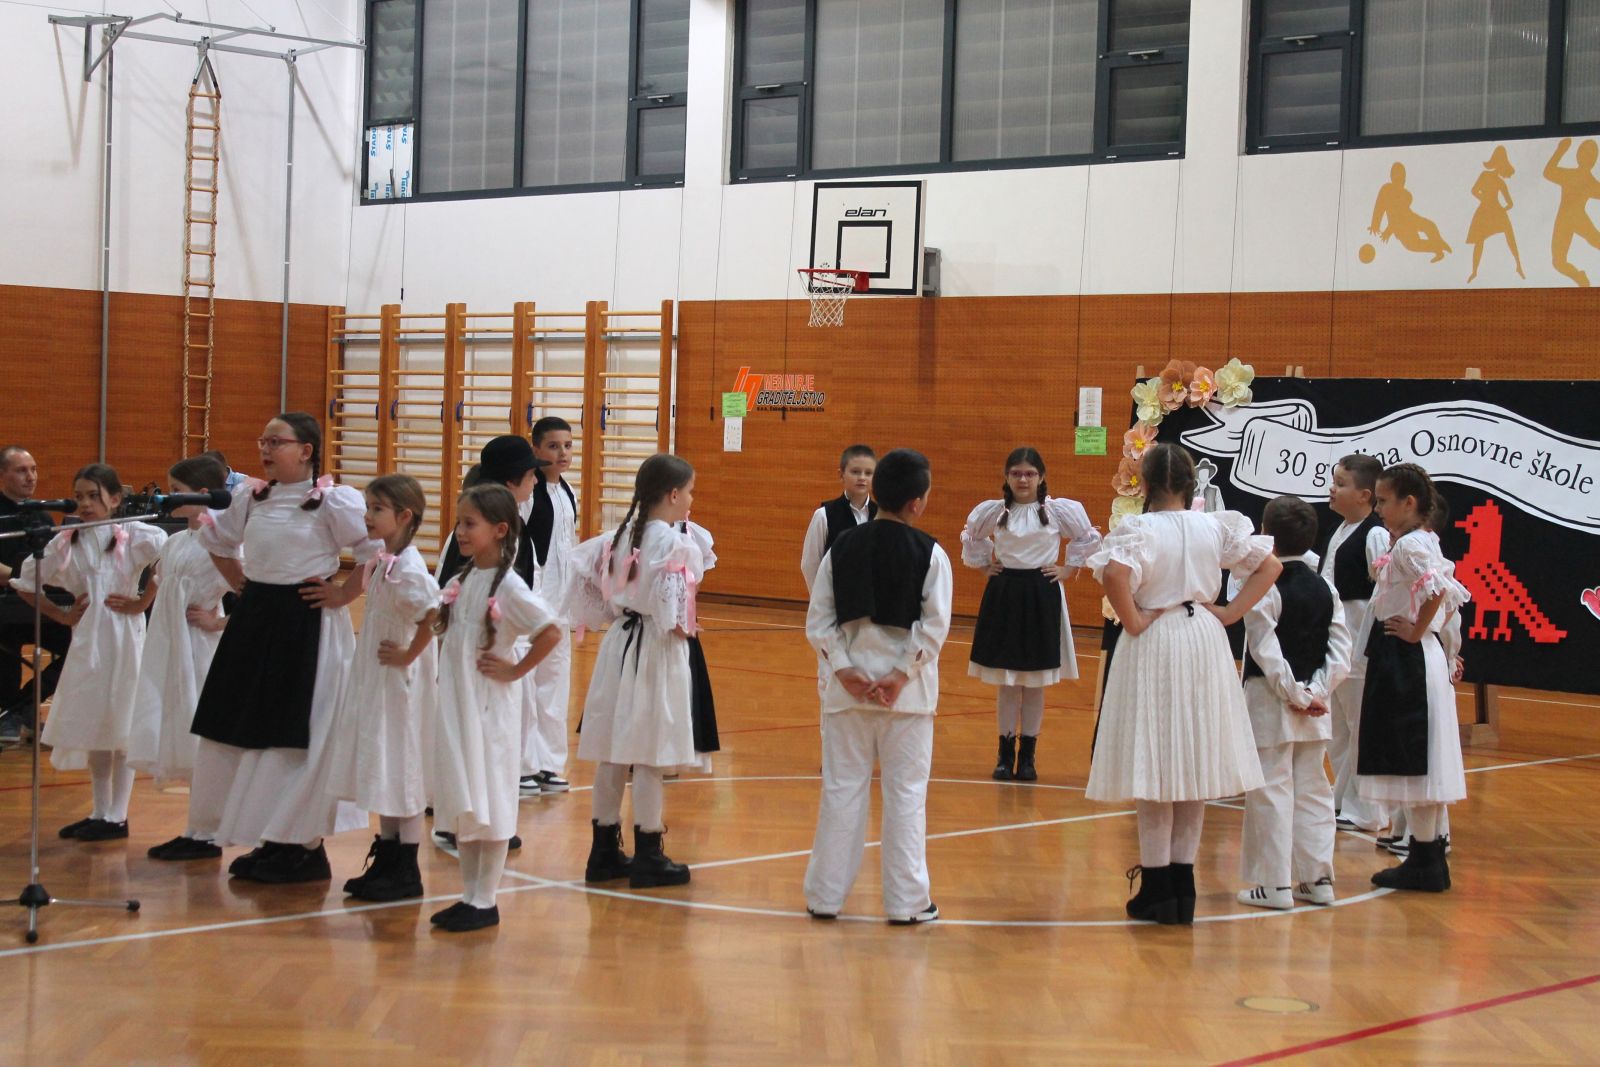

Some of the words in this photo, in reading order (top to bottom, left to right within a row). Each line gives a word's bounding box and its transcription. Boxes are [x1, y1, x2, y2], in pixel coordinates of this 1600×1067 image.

[845, 207, 886, 217] elan
[757, 391, 825, 406] GRADITELJSTVO
[1276, 449, 1307, 477] 30
[1410, 429, 1523, 469] Osnovne
[1527, 449, 1594, 495] škole
